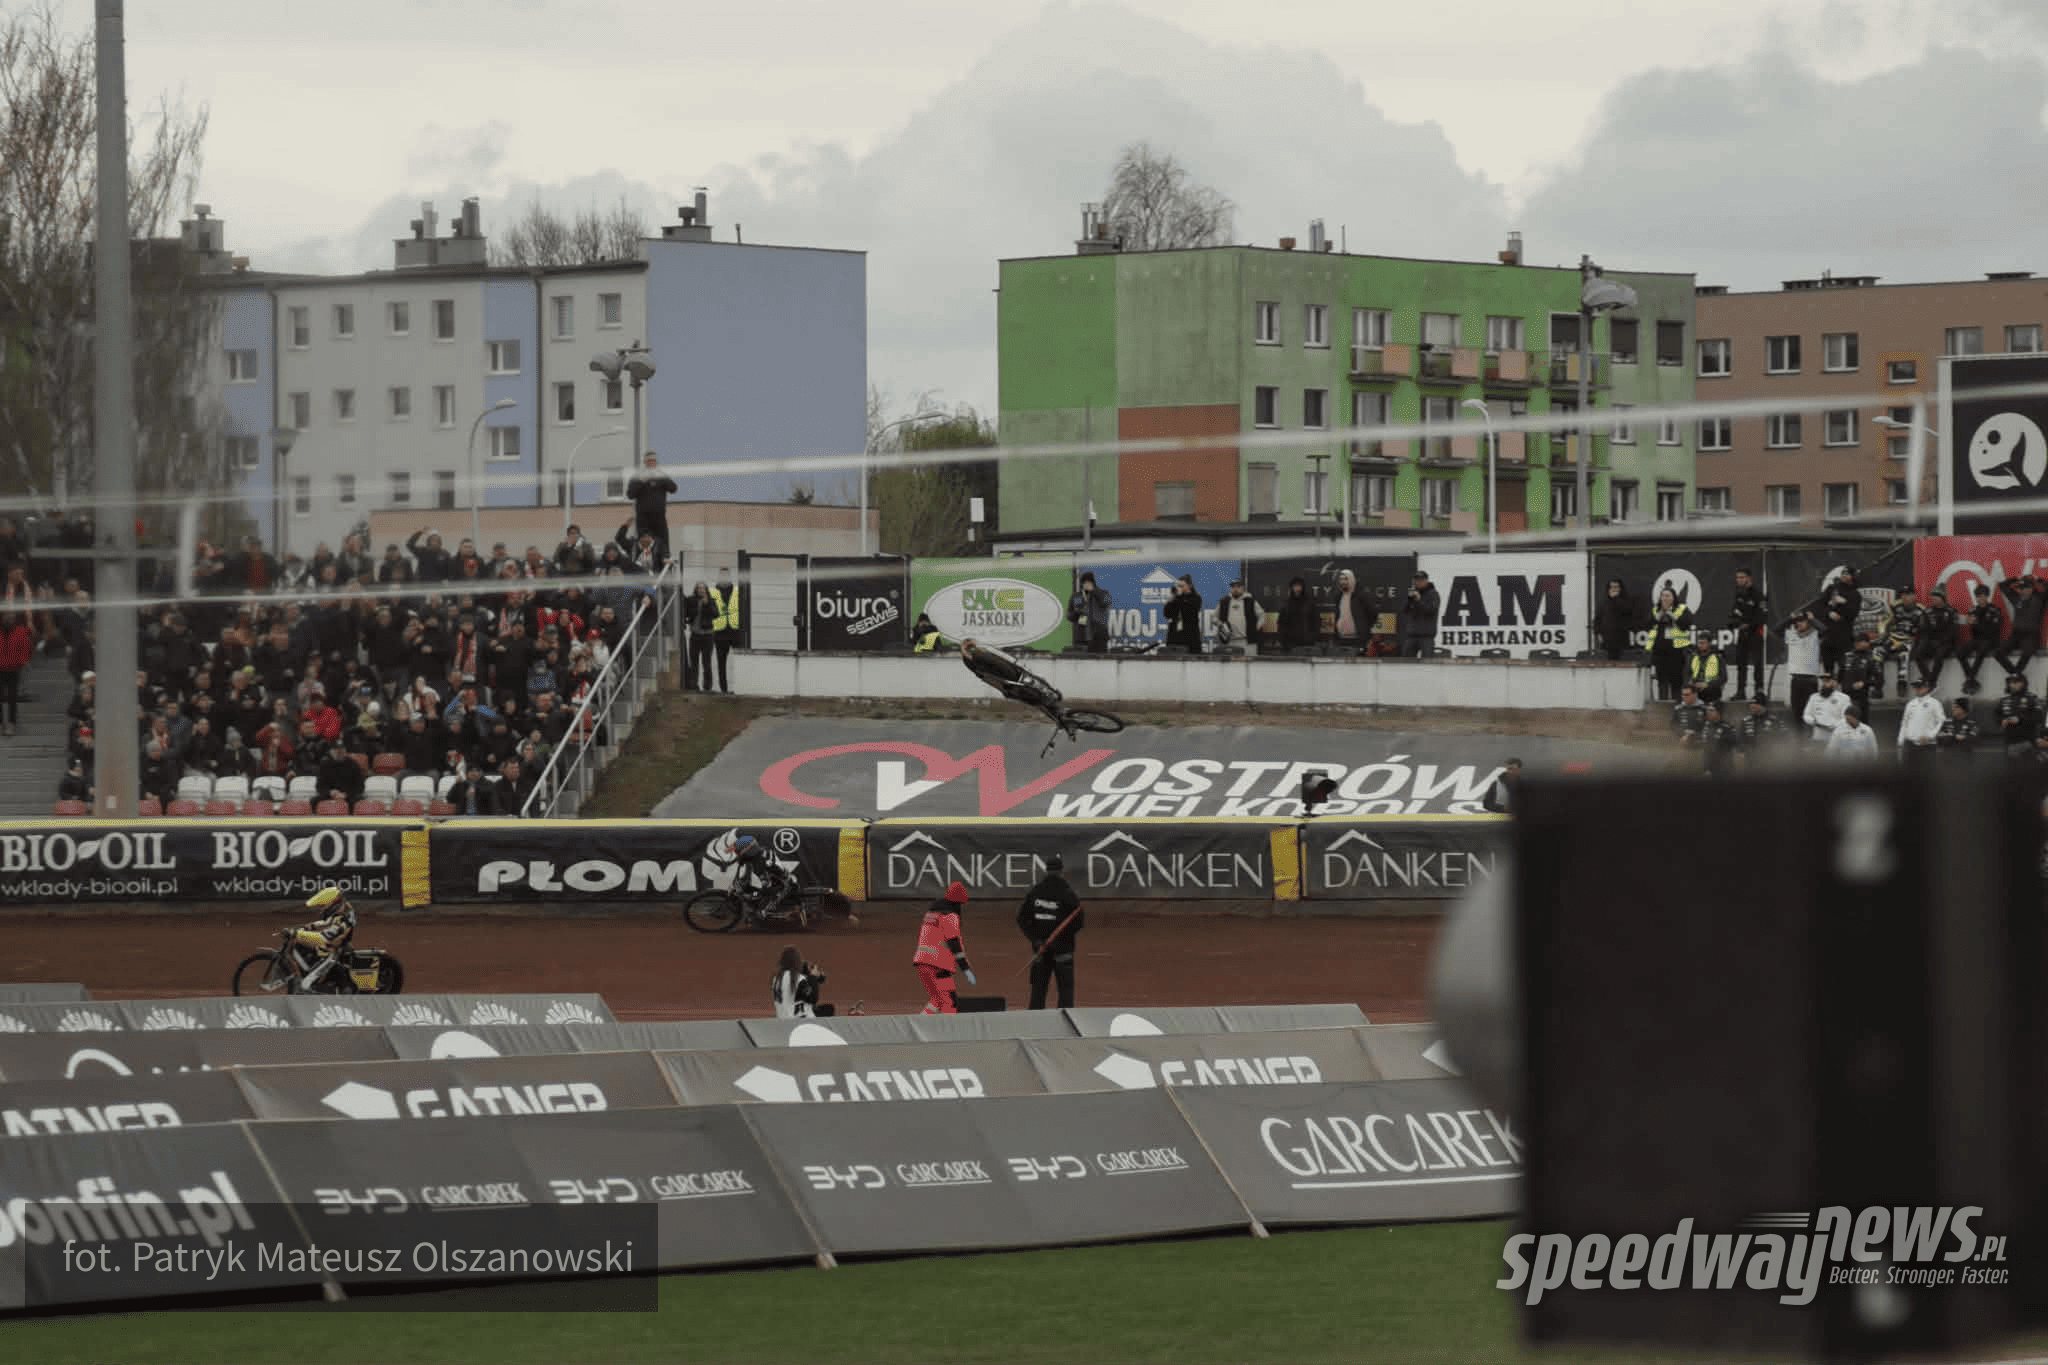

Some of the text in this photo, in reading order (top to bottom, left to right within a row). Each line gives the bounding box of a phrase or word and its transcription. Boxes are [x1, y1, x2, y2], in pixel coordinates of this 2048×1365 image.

[816, 590, 891, 618] biuro
[1441, 574, 1566, 627] AM
[846, 605, 899, 635] SERWIS
[1441, 629, 1566, 646] HERMANOS
[1091, 754, 1508, 801] OSTRÓW
[888, 853, 1061, 888] DANKEN
[1087, 852, 1263, 888] DANKEN
[1323, 851, 1496, 888] DANKEN
[1259, 1108, 1525, 1177] GARCAREK
[896, 1160, 991, 1184] GARCAREK
[1095, 1147, 1188, 1172] GARCAREK
[420, 1182, 529, 1206] GARCAREK
[650, 1169, 752, 1196] GARCAREK
